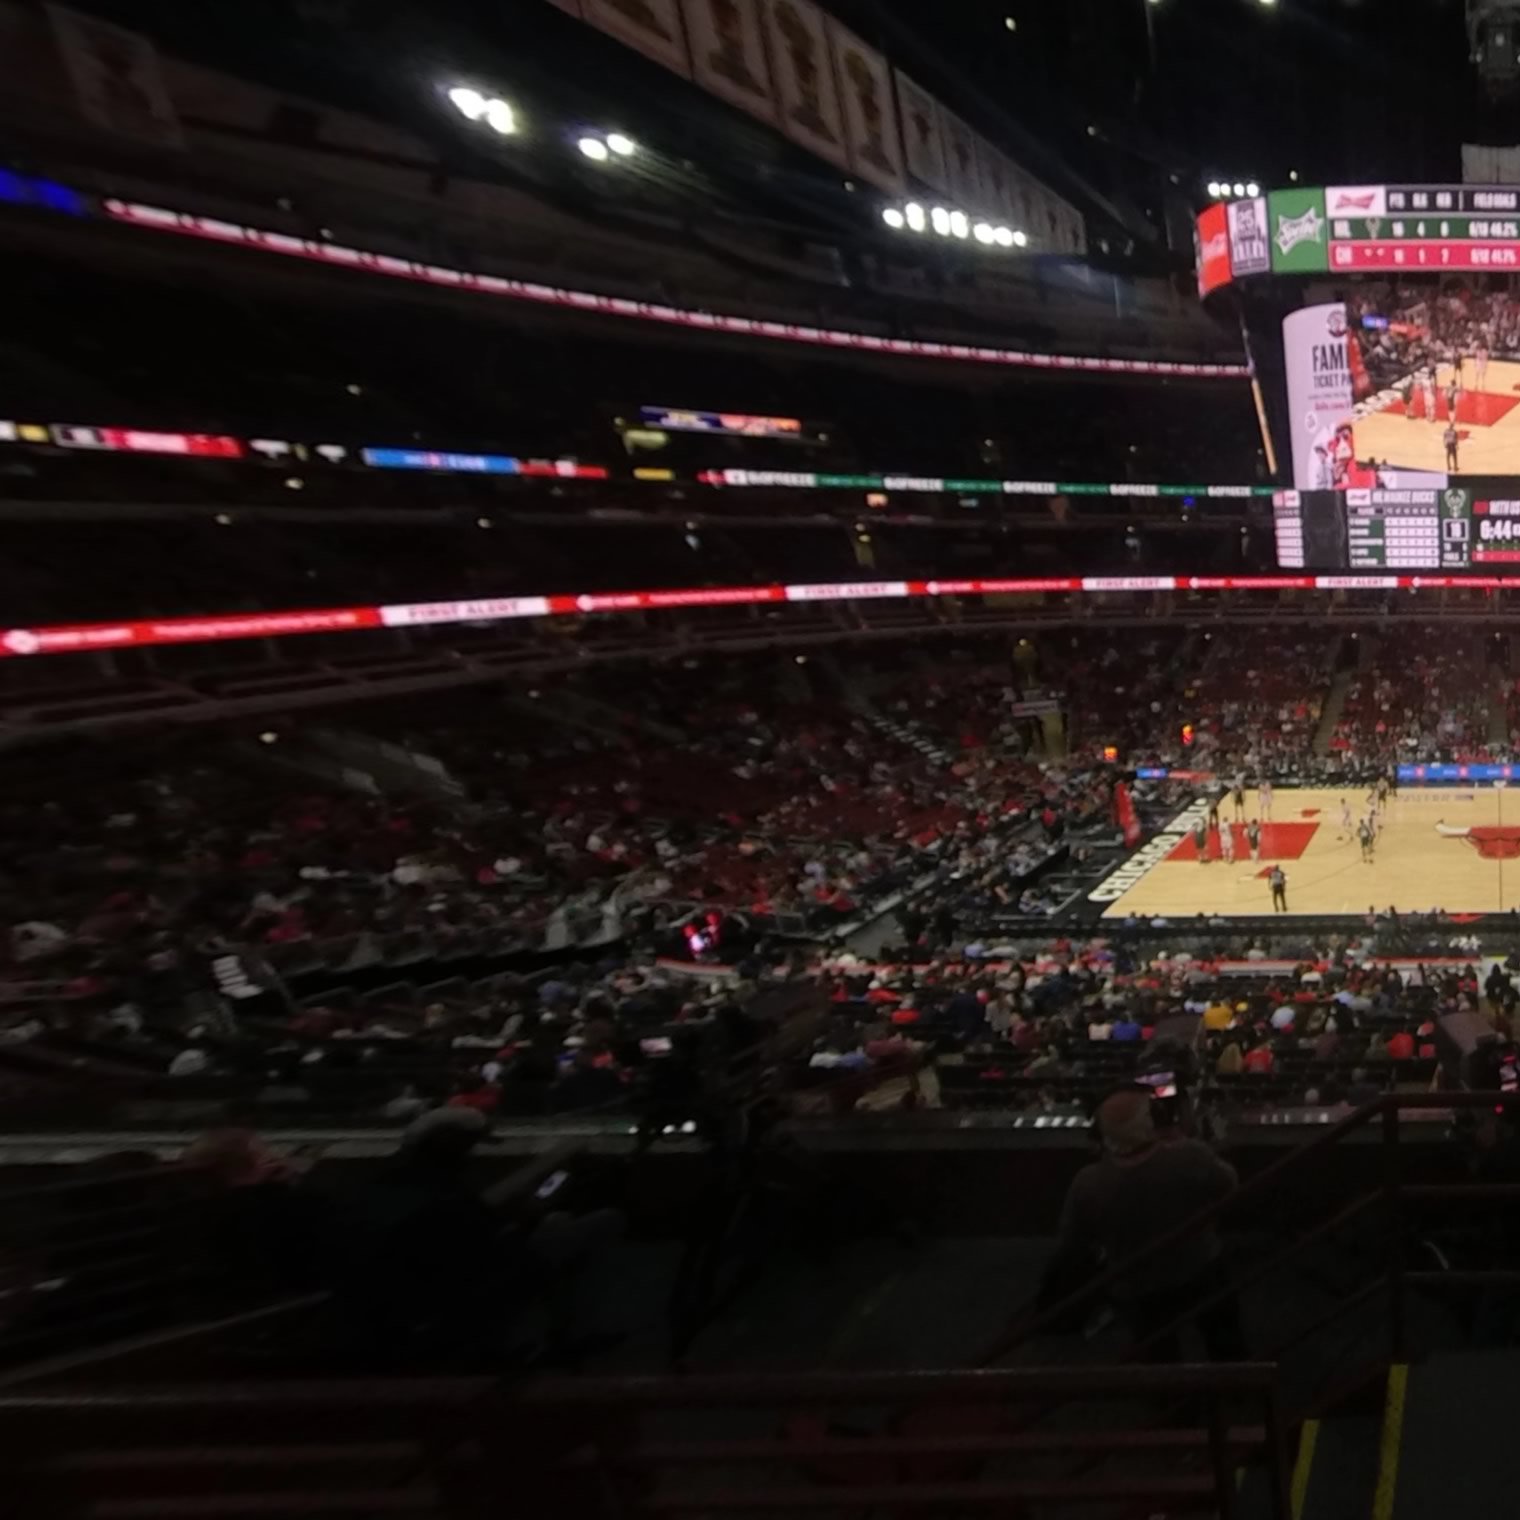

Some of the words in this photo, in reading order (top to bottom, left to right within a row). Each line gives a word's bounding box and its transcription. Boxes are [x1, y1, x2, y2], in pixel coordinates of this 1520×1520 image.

[1096, 579, 1124, 588] FIRST
[1128, 578, 1159, 587] ALERT
[1328, 578, 1353, 586] FIRST
[1355, 578, 1384, 586] ALERT
[805, 584, 841, 596] FIRST
[847, 583, 888, 595] ALERT
[409, 605, 459, 620] FIRST
[466, 601, 520, 615] ALERT
[1087, 834, 1181, 902] CHICAGO
